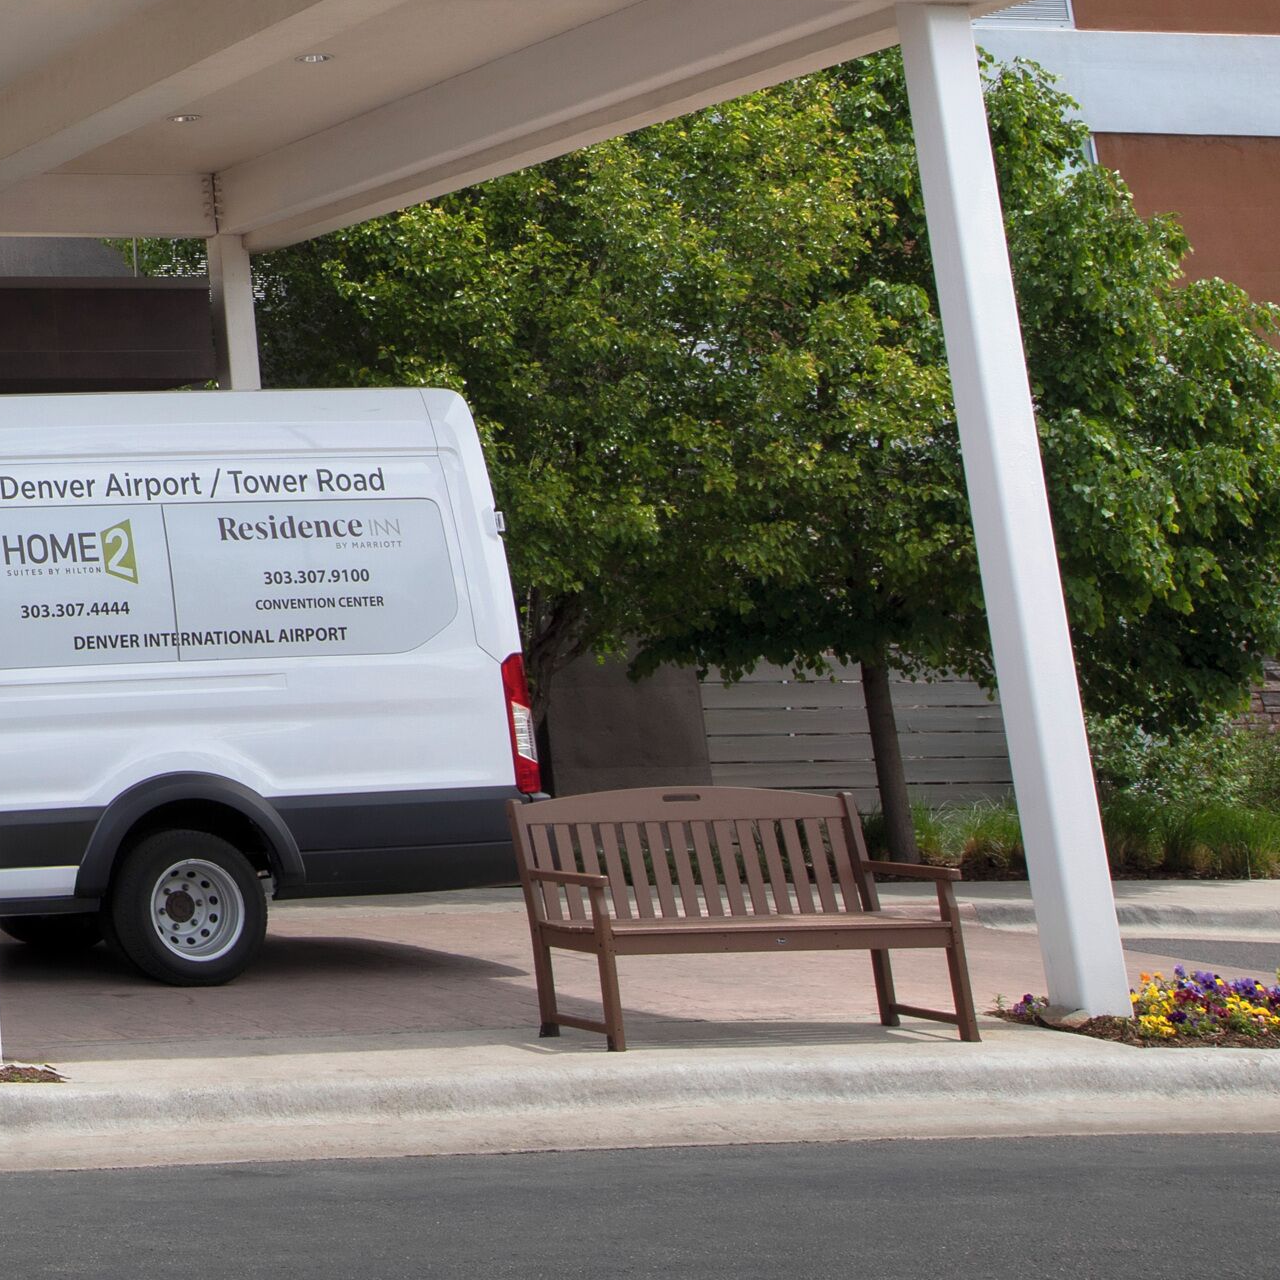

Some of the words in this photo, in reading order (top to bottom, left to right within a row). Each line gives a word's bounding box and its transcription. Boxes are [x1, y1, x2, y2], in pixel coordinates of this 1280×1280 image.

[0, 476, 96, 500] Denver
[105, 472, 202, 501] Airport
[227, 470, 308, 495] Tower
[316, 467, 386, 493] Road
[217, 515, 364, 542] Residence
[368, 518, 402, 537] INN
[335, 541, 348, 550] BY
[351, 540, 403, 549] MARRIOTT
[6, 568, 44, 577] SUITES
[48, 567, 61, 576] BY
[65, 566, 102, 575] HILTON
[263, 568, 370, 585] 303.307.9100
[20, 601, 131, 619] 303.307.4444
[255, 597, 336, 611] CONVENTION
[338, 595, 385, 608] CENTER
[73, 633, 140, 650] DENVER
[143, 629, 275, 647] INTERNATIONAL
[277, 626, 348, 643] AIRPORT
